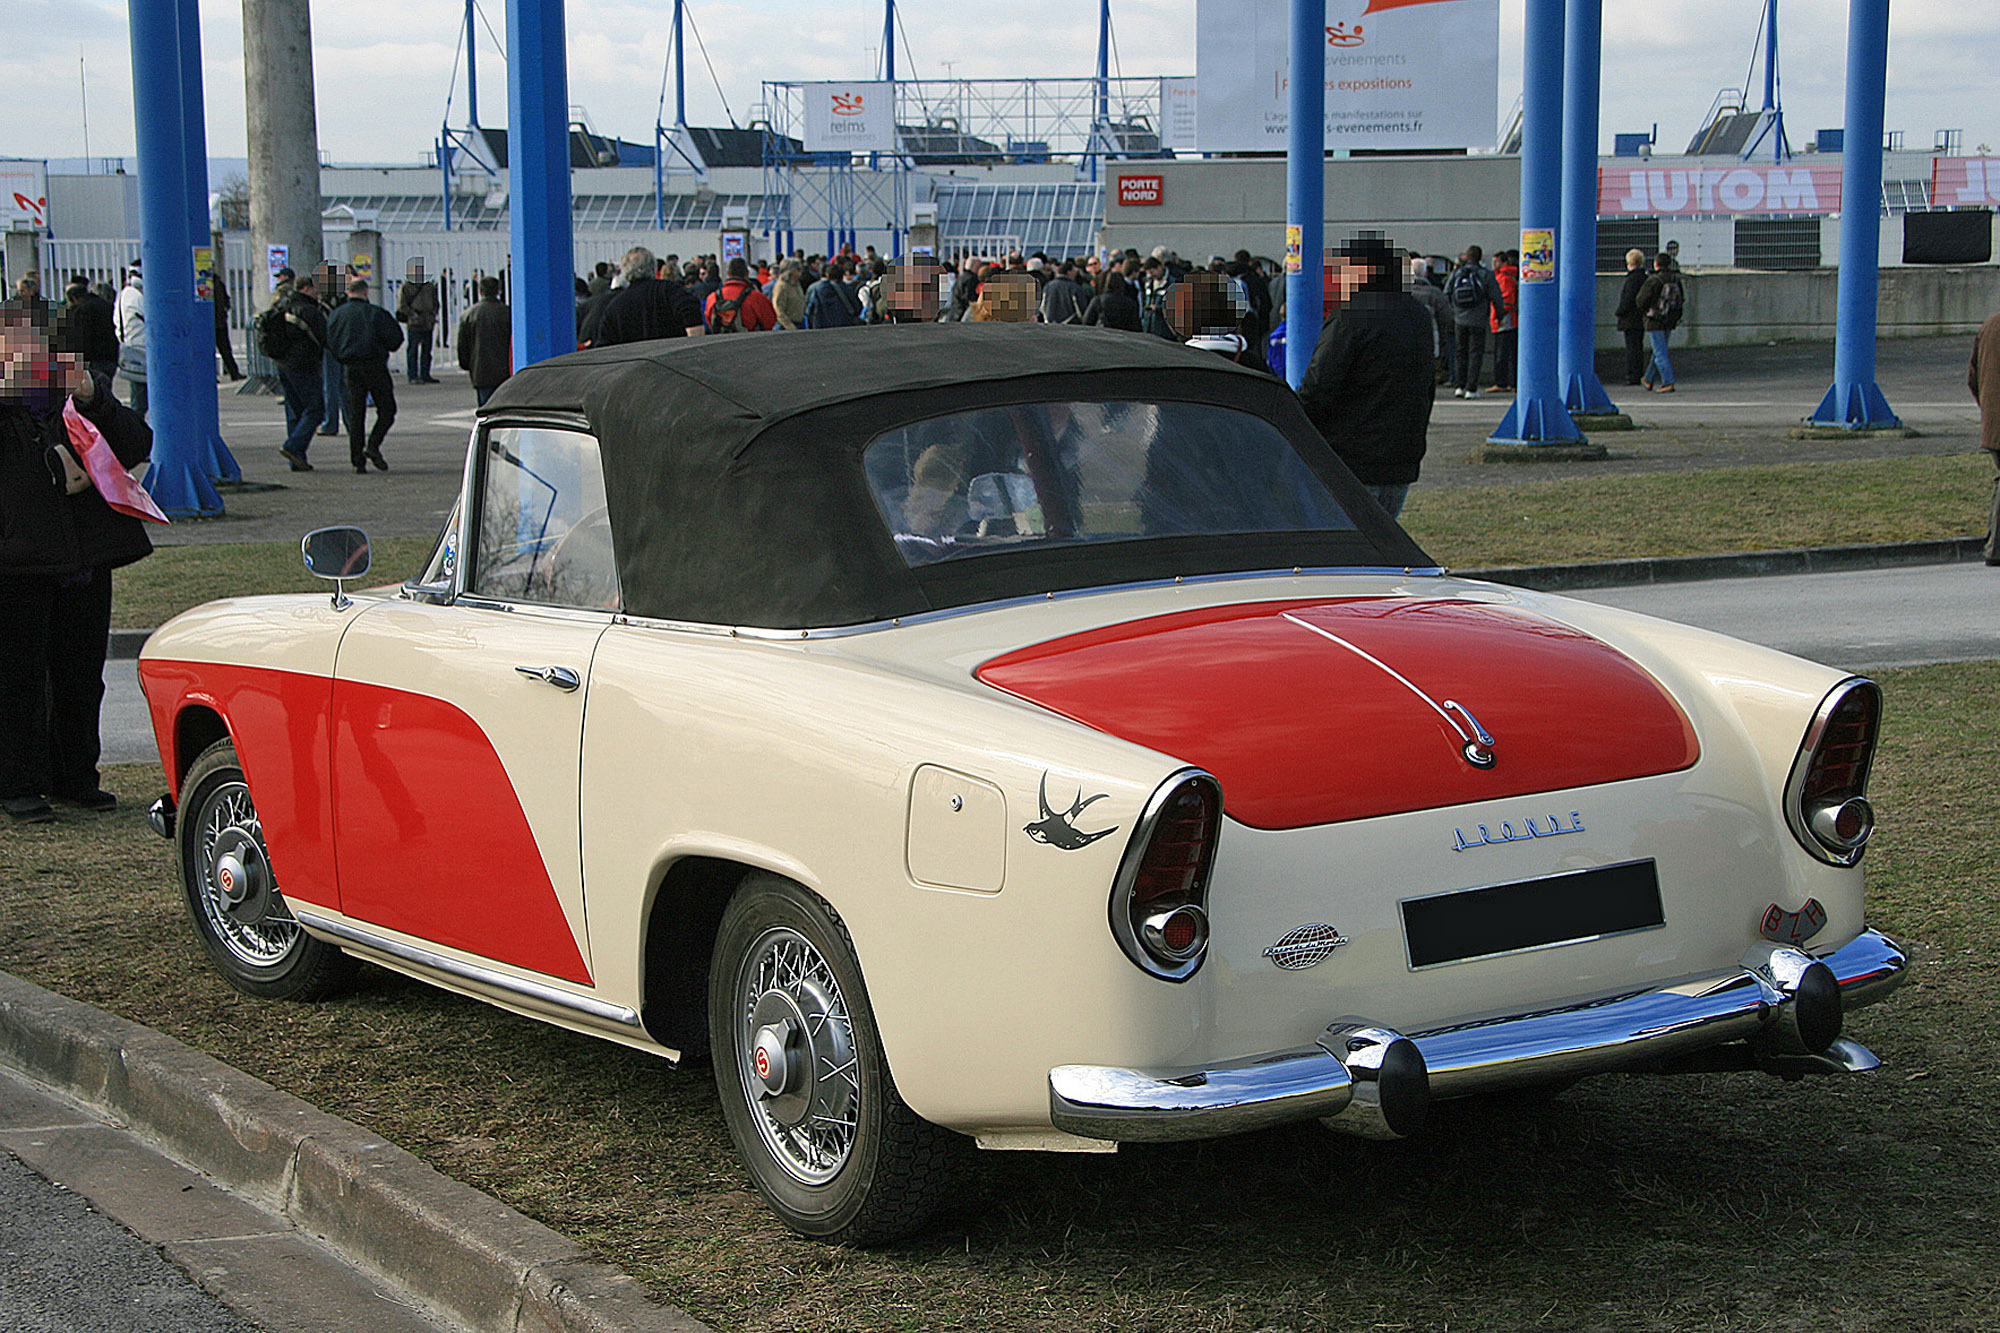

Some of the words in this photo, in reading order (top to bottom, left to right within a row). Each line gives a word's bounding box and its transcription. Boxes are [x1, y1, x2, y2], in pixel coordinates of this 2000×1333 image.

[1338, 76, 1412, 92] expositions
[1331, 109, 1404, 120] manifestations
[1407, 110, 1423, 119] sur
[830, 119, 866, 133] reims
[1121, 179, 1159, 190] PORTE
[1123, 190, 1157, 201] NORD
[1452, 810, 1586, 851] ARONDE
[1766, 901, 1824, 938] BZH
